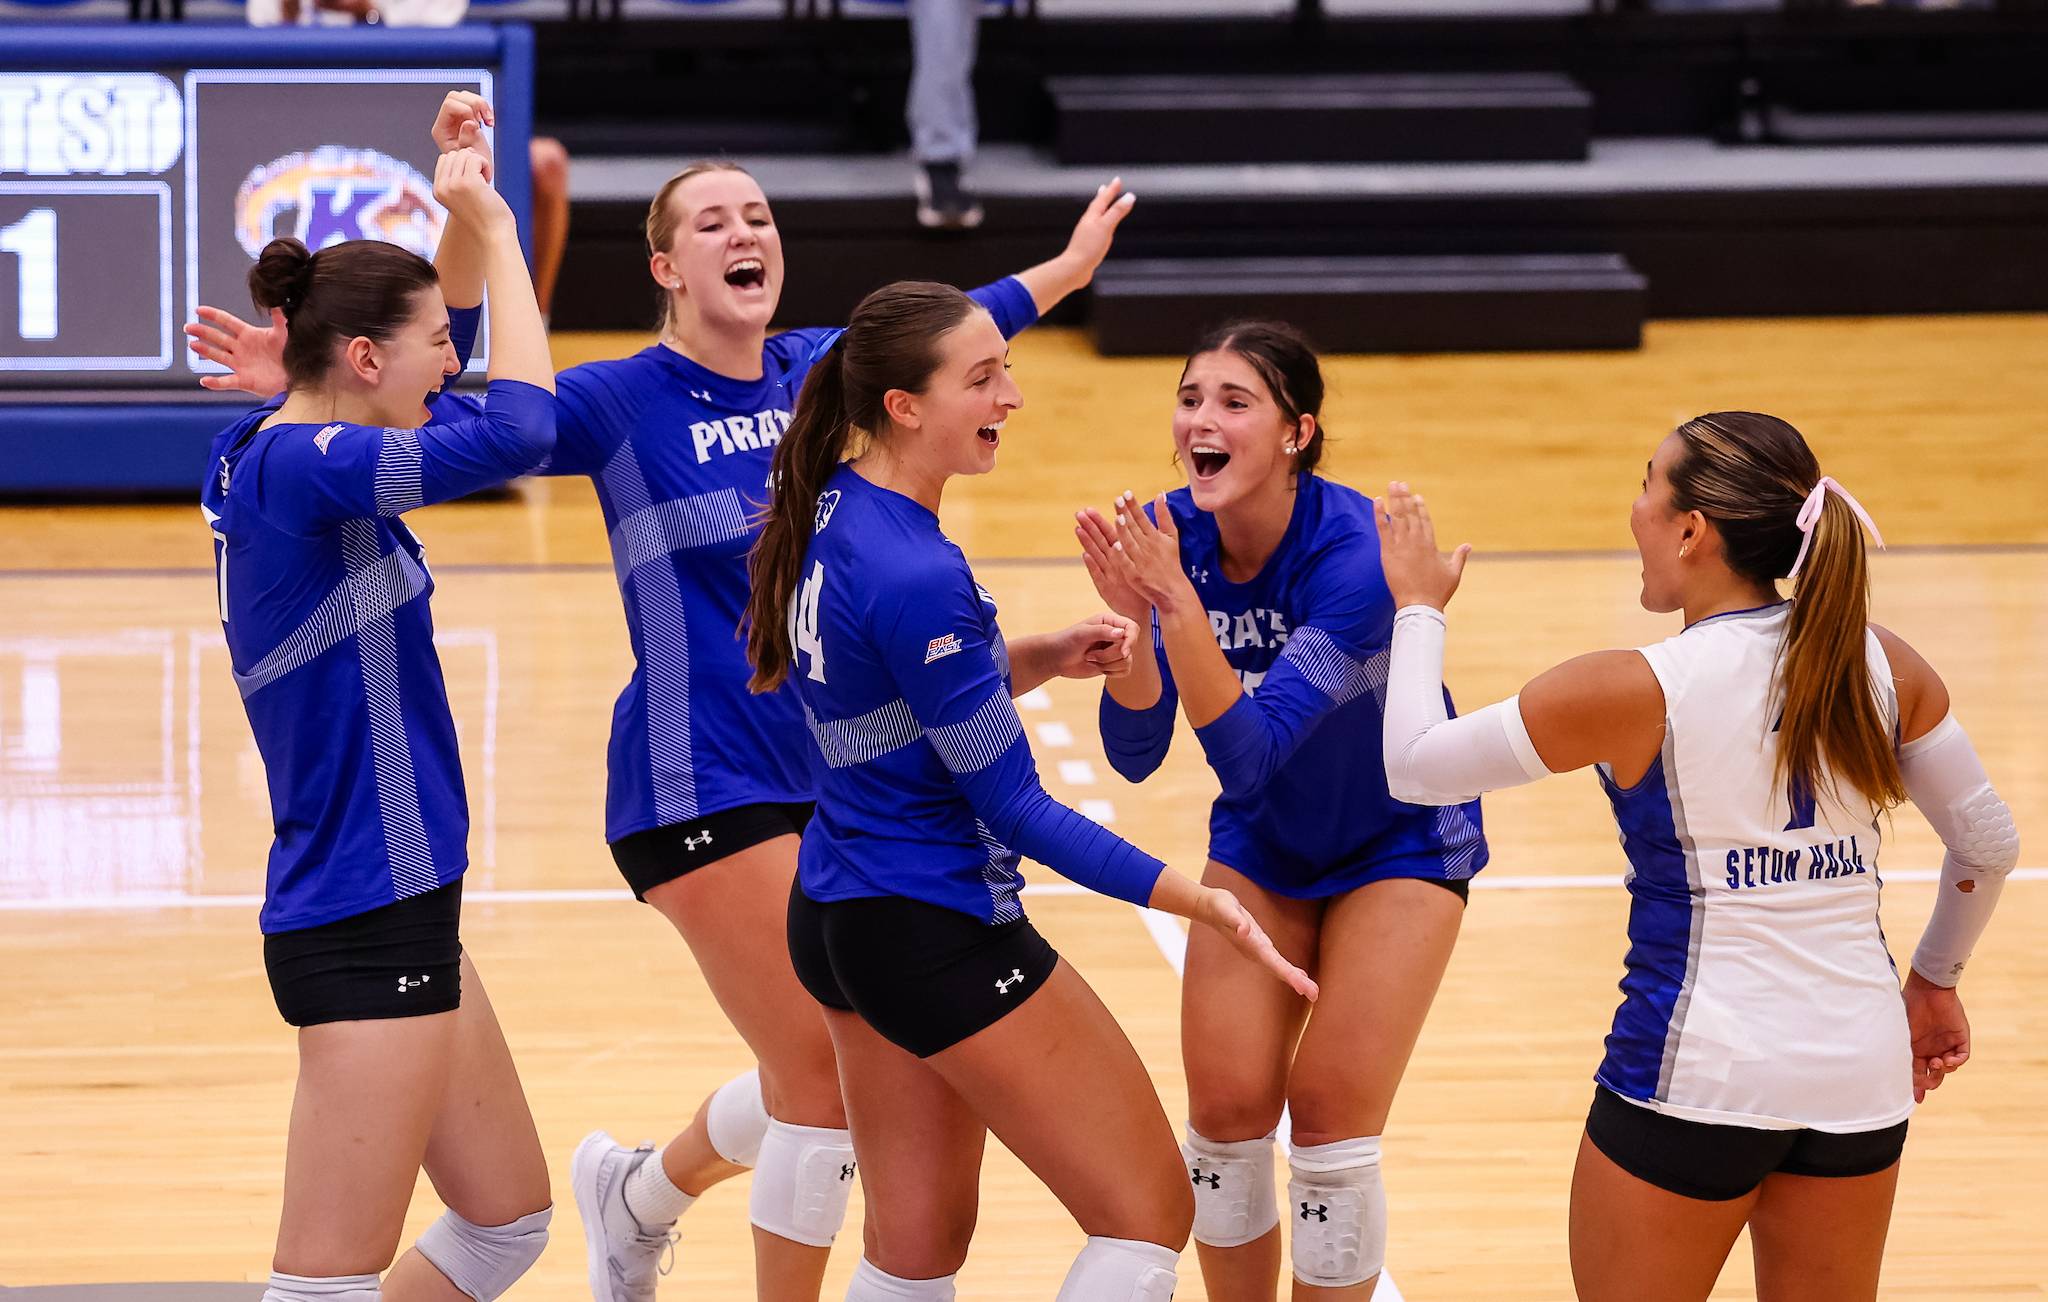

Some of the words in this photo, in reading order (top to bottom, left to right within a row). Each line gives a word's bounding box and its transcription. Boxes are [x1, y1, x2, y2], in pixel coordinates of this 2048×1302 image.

[688, 409, 796, 464] PIRAT
[928, 640, 962, 656] EAST
[929, 635, 953, 649] BIG
[1726, 845, 1800, 889] SETON
[1808, 835, 1866, 881] HALL
